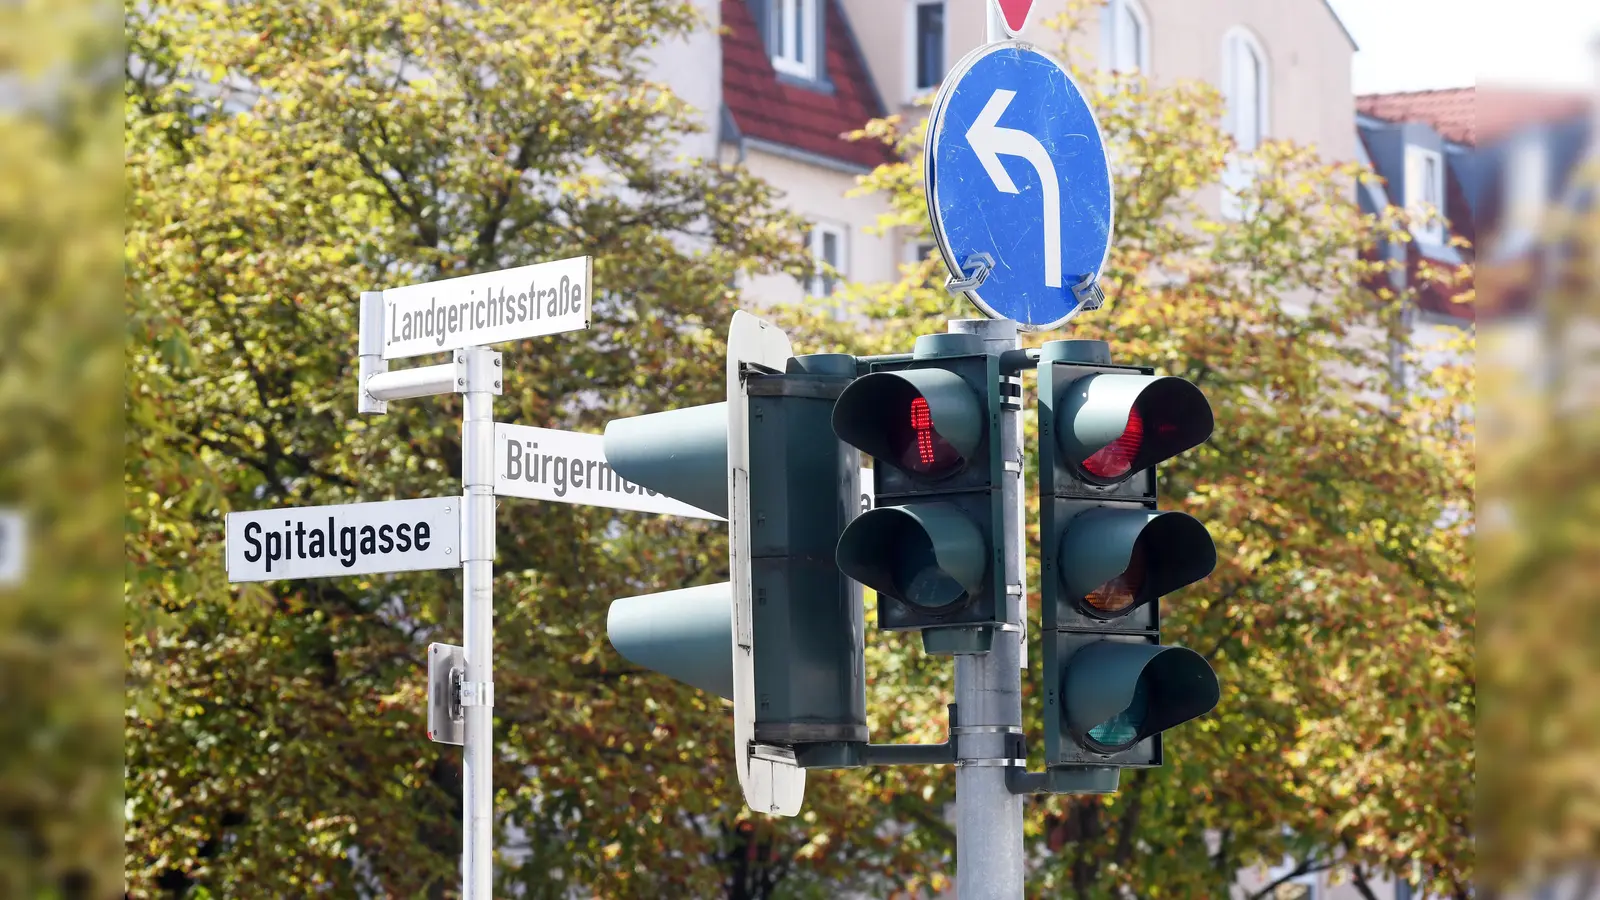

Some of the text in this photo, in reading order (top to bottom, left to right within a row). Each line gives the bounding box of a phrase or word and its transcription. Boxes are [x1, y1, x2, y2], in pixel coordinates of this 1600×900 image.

[391, 275, 582, 347] Landgerichtsstraße
[506, 439, 669, 498] Bürgerm
[243, 516, 431, 573] Spitalgasse
